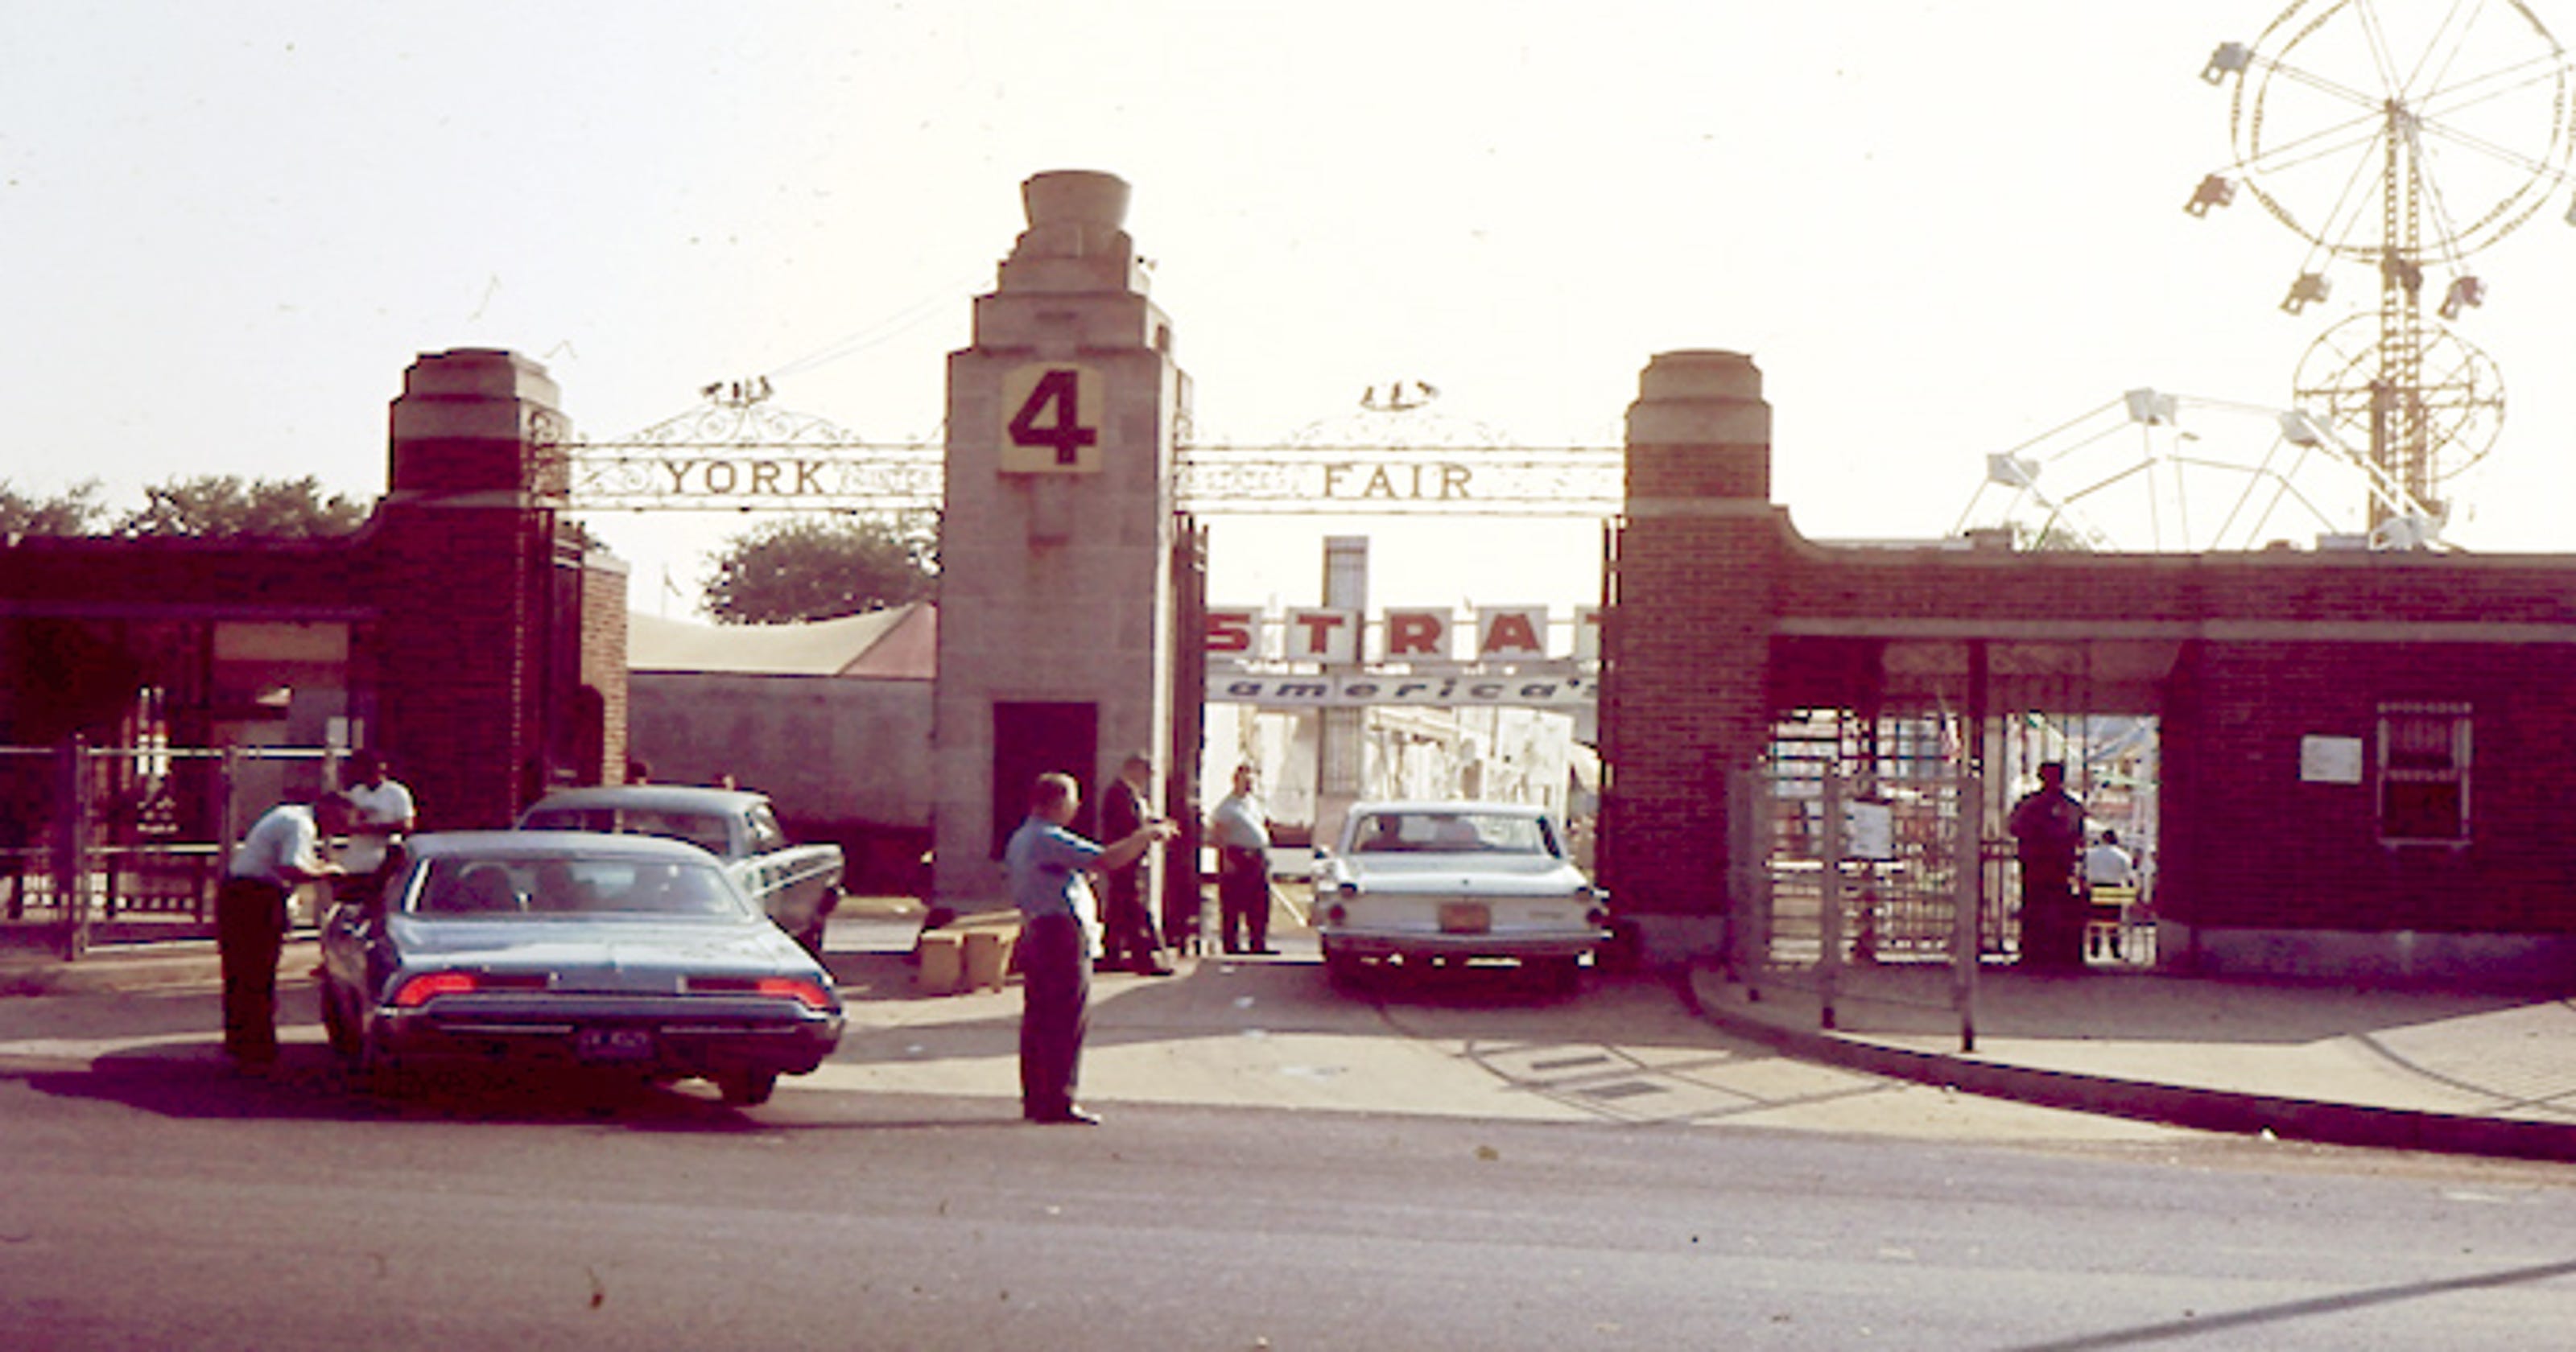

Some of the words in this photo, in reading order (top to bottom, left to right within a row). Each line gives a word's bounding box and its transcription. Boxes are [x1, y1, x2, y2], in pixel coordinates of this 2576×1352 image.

[1007, 369, 1098, 464] 4
[663, 460, 824, 494] YORK
[1323, 461, 1472, 500] FAIR
